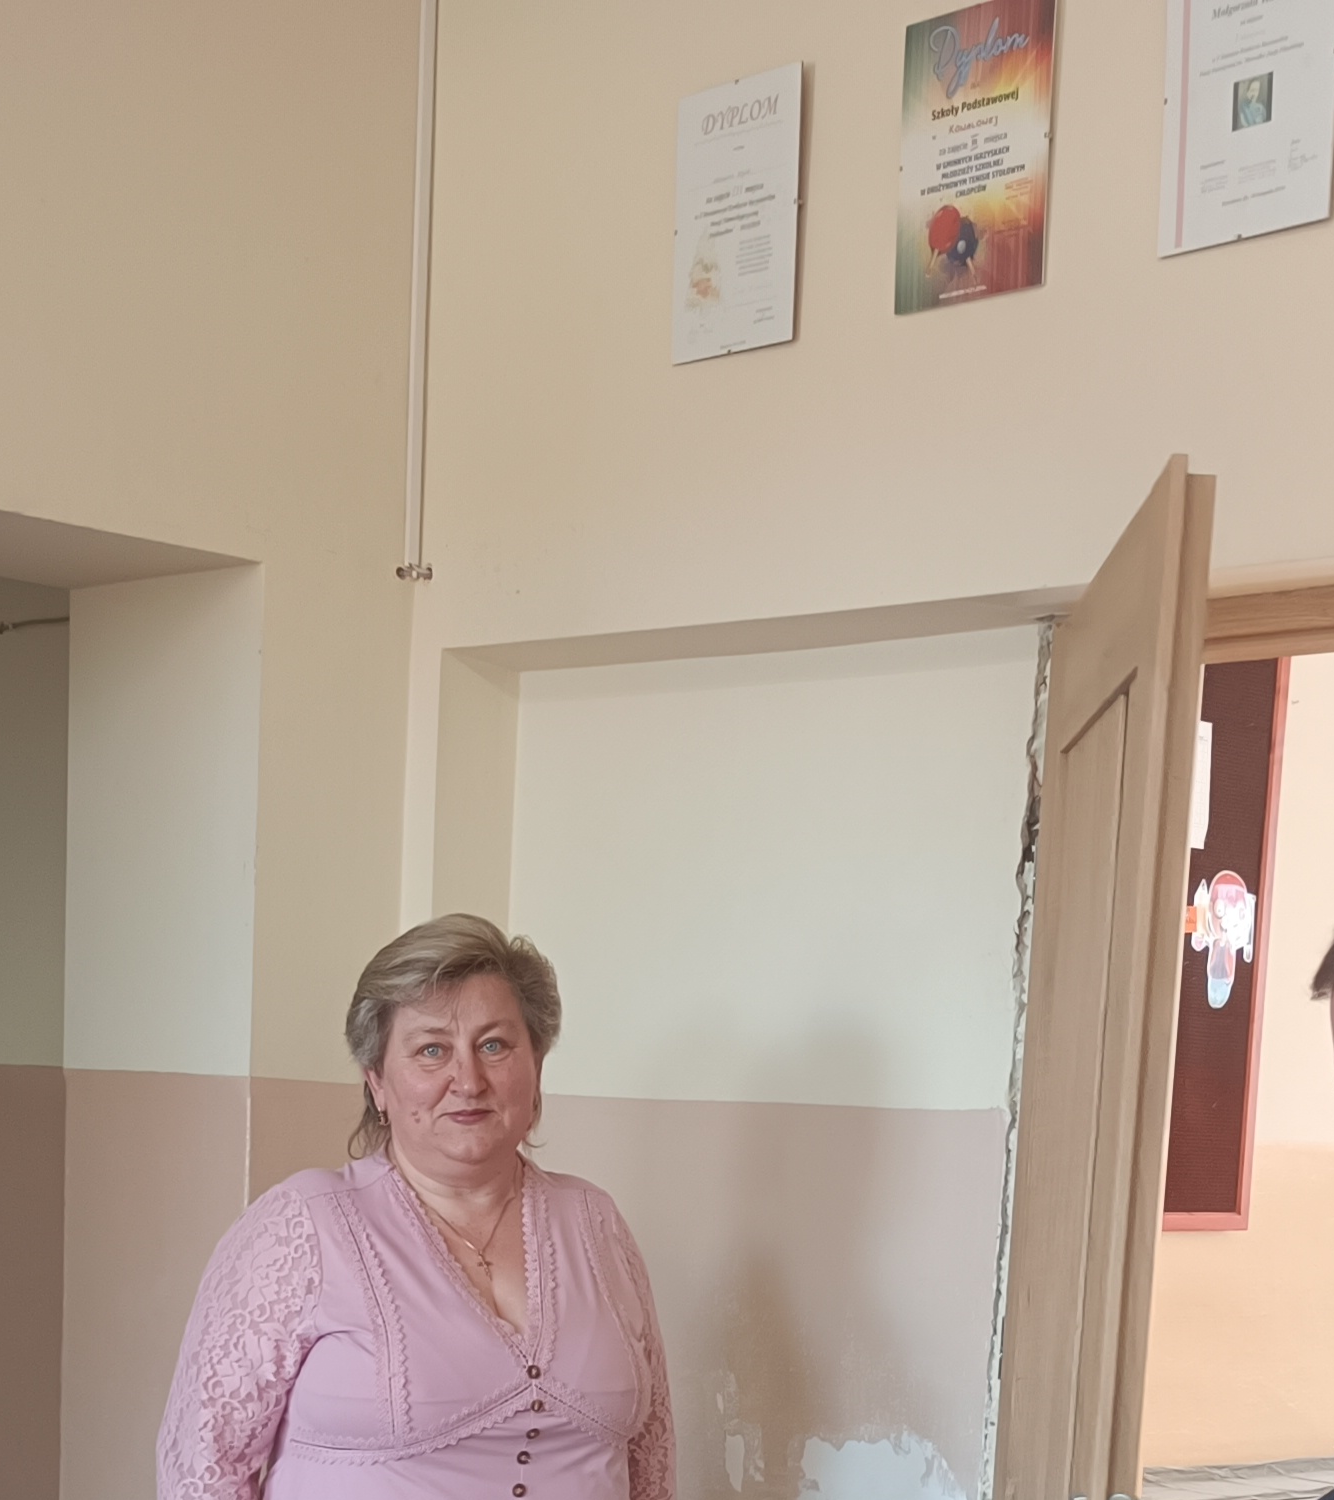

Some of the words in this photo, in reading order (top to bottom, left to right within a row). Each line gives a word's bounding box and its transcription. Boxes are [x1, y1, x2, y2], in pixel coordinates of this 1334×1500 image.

[929, 17, 1030, 100] Dyplom
[701, 93, 780, 136] DYPLOM
[931, 104, 960, 122] Szkoły
[961, 86, 1020, 113] Podstawowej
